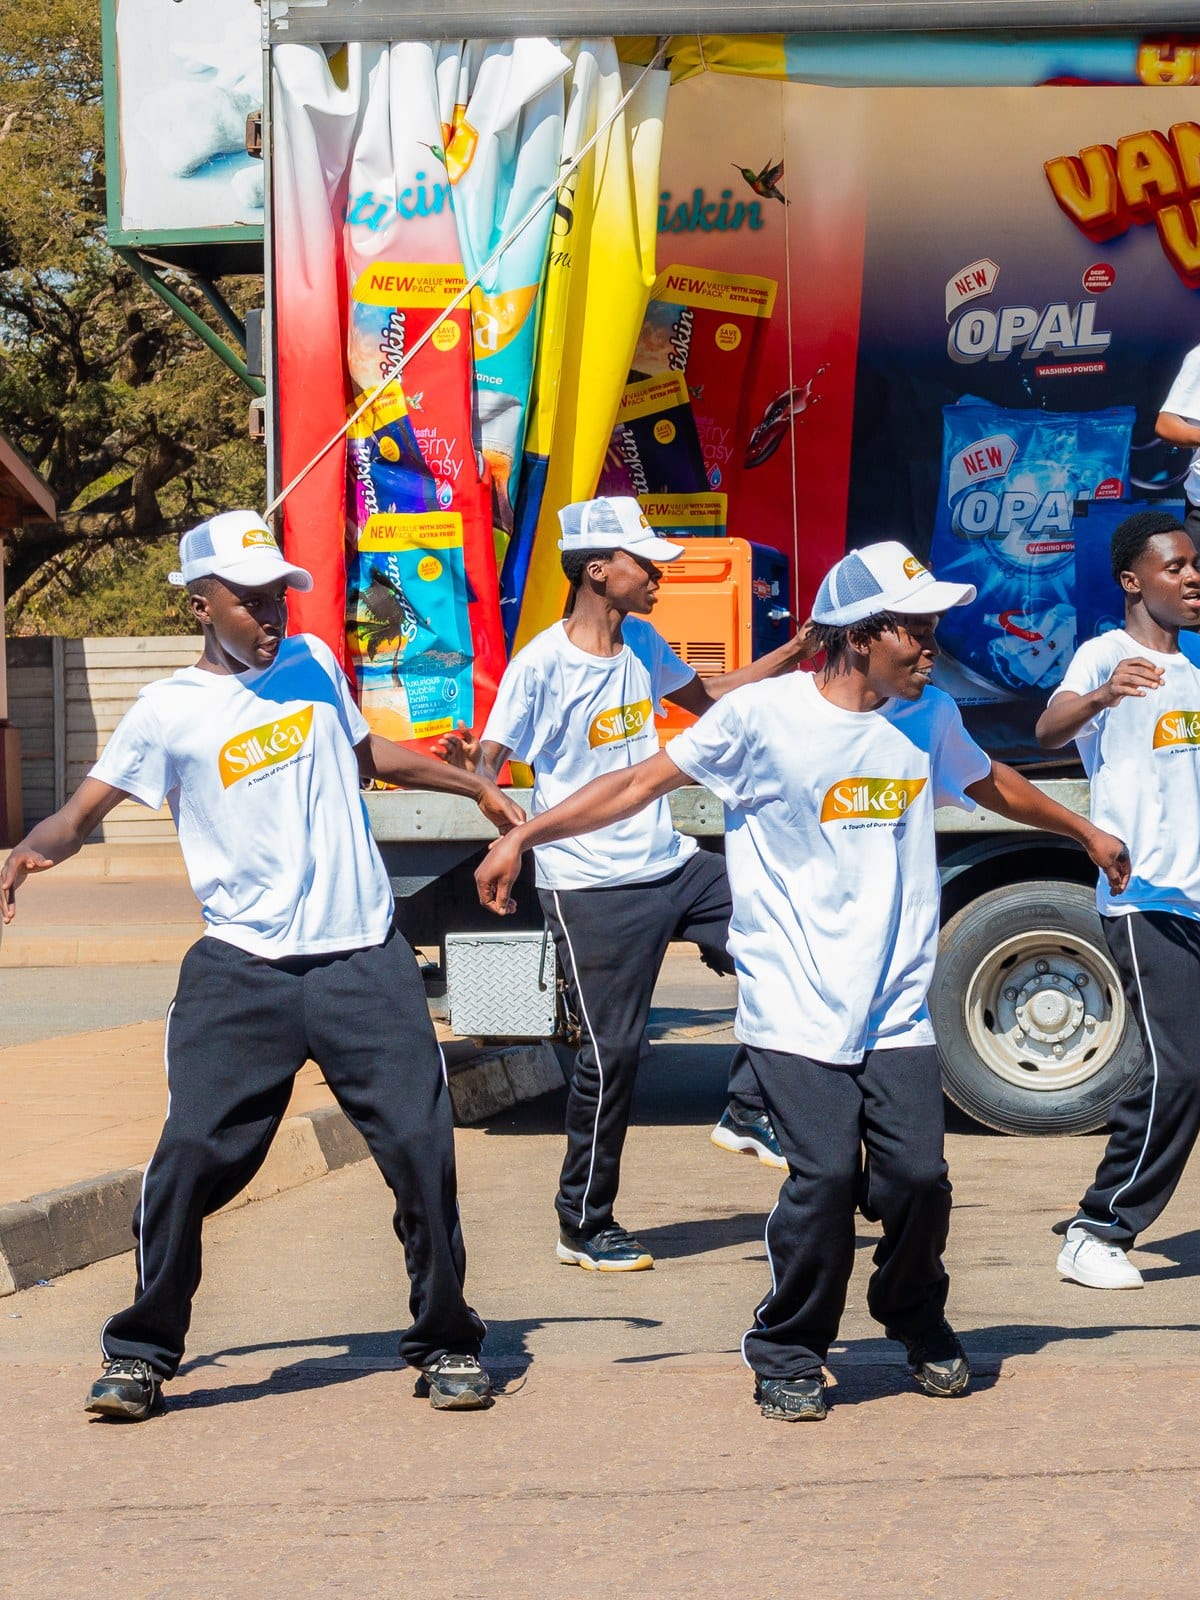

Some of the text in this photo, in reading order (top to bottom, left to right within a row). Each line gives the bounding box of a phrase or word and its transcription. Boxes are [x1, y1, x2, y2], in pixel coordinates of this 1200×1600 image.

[370, 275, 415, 292] NEW
[412, 285, 436, 294] PACK
[416, 277, 444, 286] VALUE
[666, 275, 706, 294] NEW
[706, 282, 731, 292] VALUE
[954, 268, 988, 297] NEW
[702, 289, 723, 298] PACK
[948, 300, 1112, 362] OPAL
[1073, 364, 1104, 373] POWDER
[962, 446, 1003, 476] NEW
[370, 525, 397, 539] NEW
[224, 723, 304, 773] Silkéa
[253, 772, 270, 784] Touch
[276, 763, 289, 773] Pure
[833, 781, 907, 814] Silkéa
